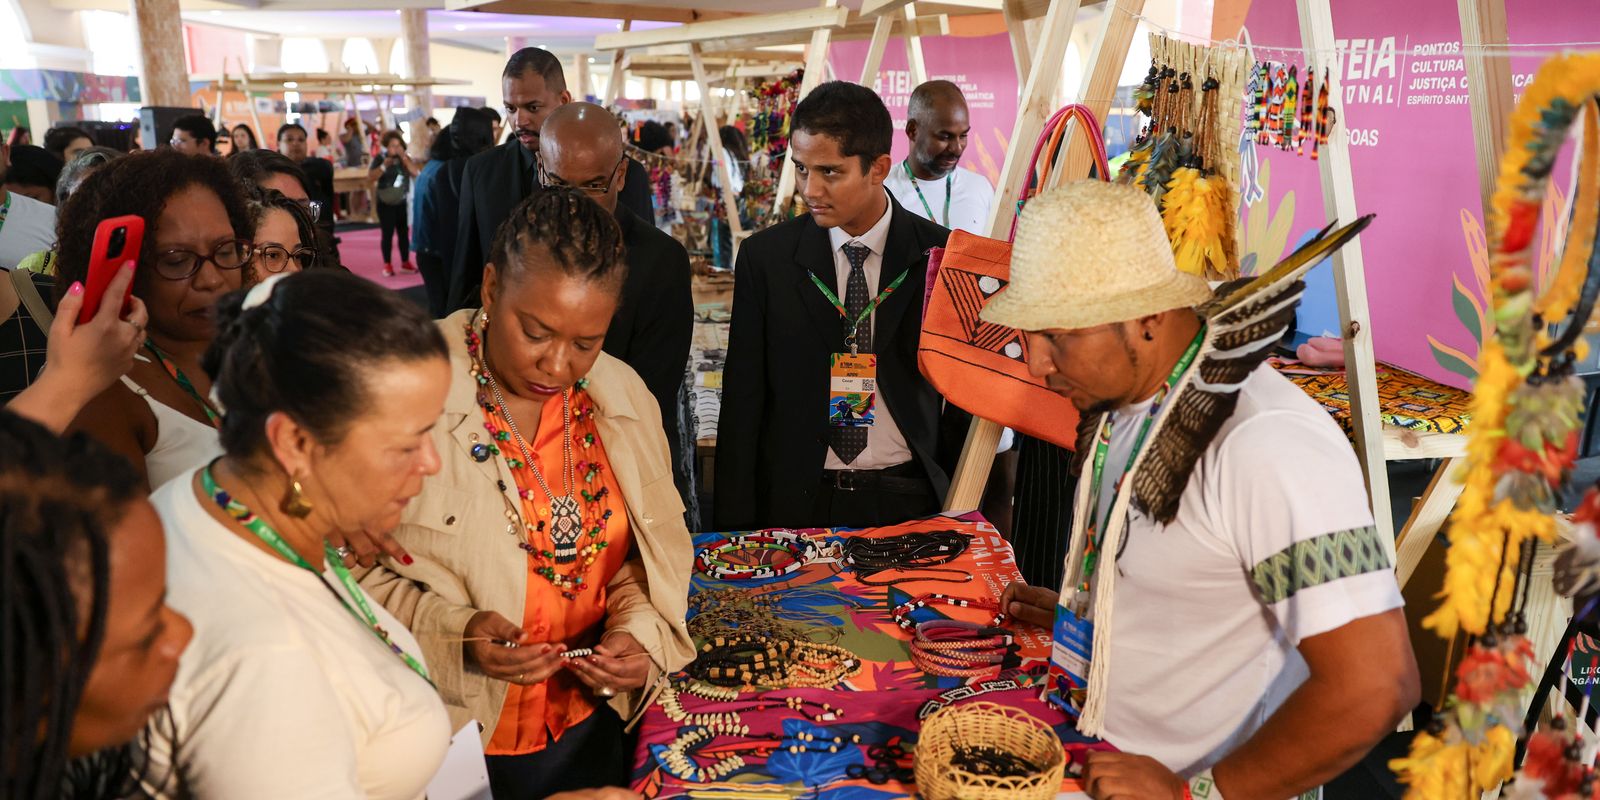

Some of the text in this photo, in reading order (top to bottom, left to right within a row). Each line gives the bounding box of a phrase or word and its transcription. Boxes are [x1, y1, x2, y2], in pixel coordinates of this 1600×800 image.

[1413, 41, 1459, 57] PONTOS
[1411, 59, 1464, 74] CULTURA
[887, 70, 912, 94] TEI
[1409, 77, 1456, 92] JUSTIÇA
[1407, 94, 1469, 105] ESPÍRITO SANT
